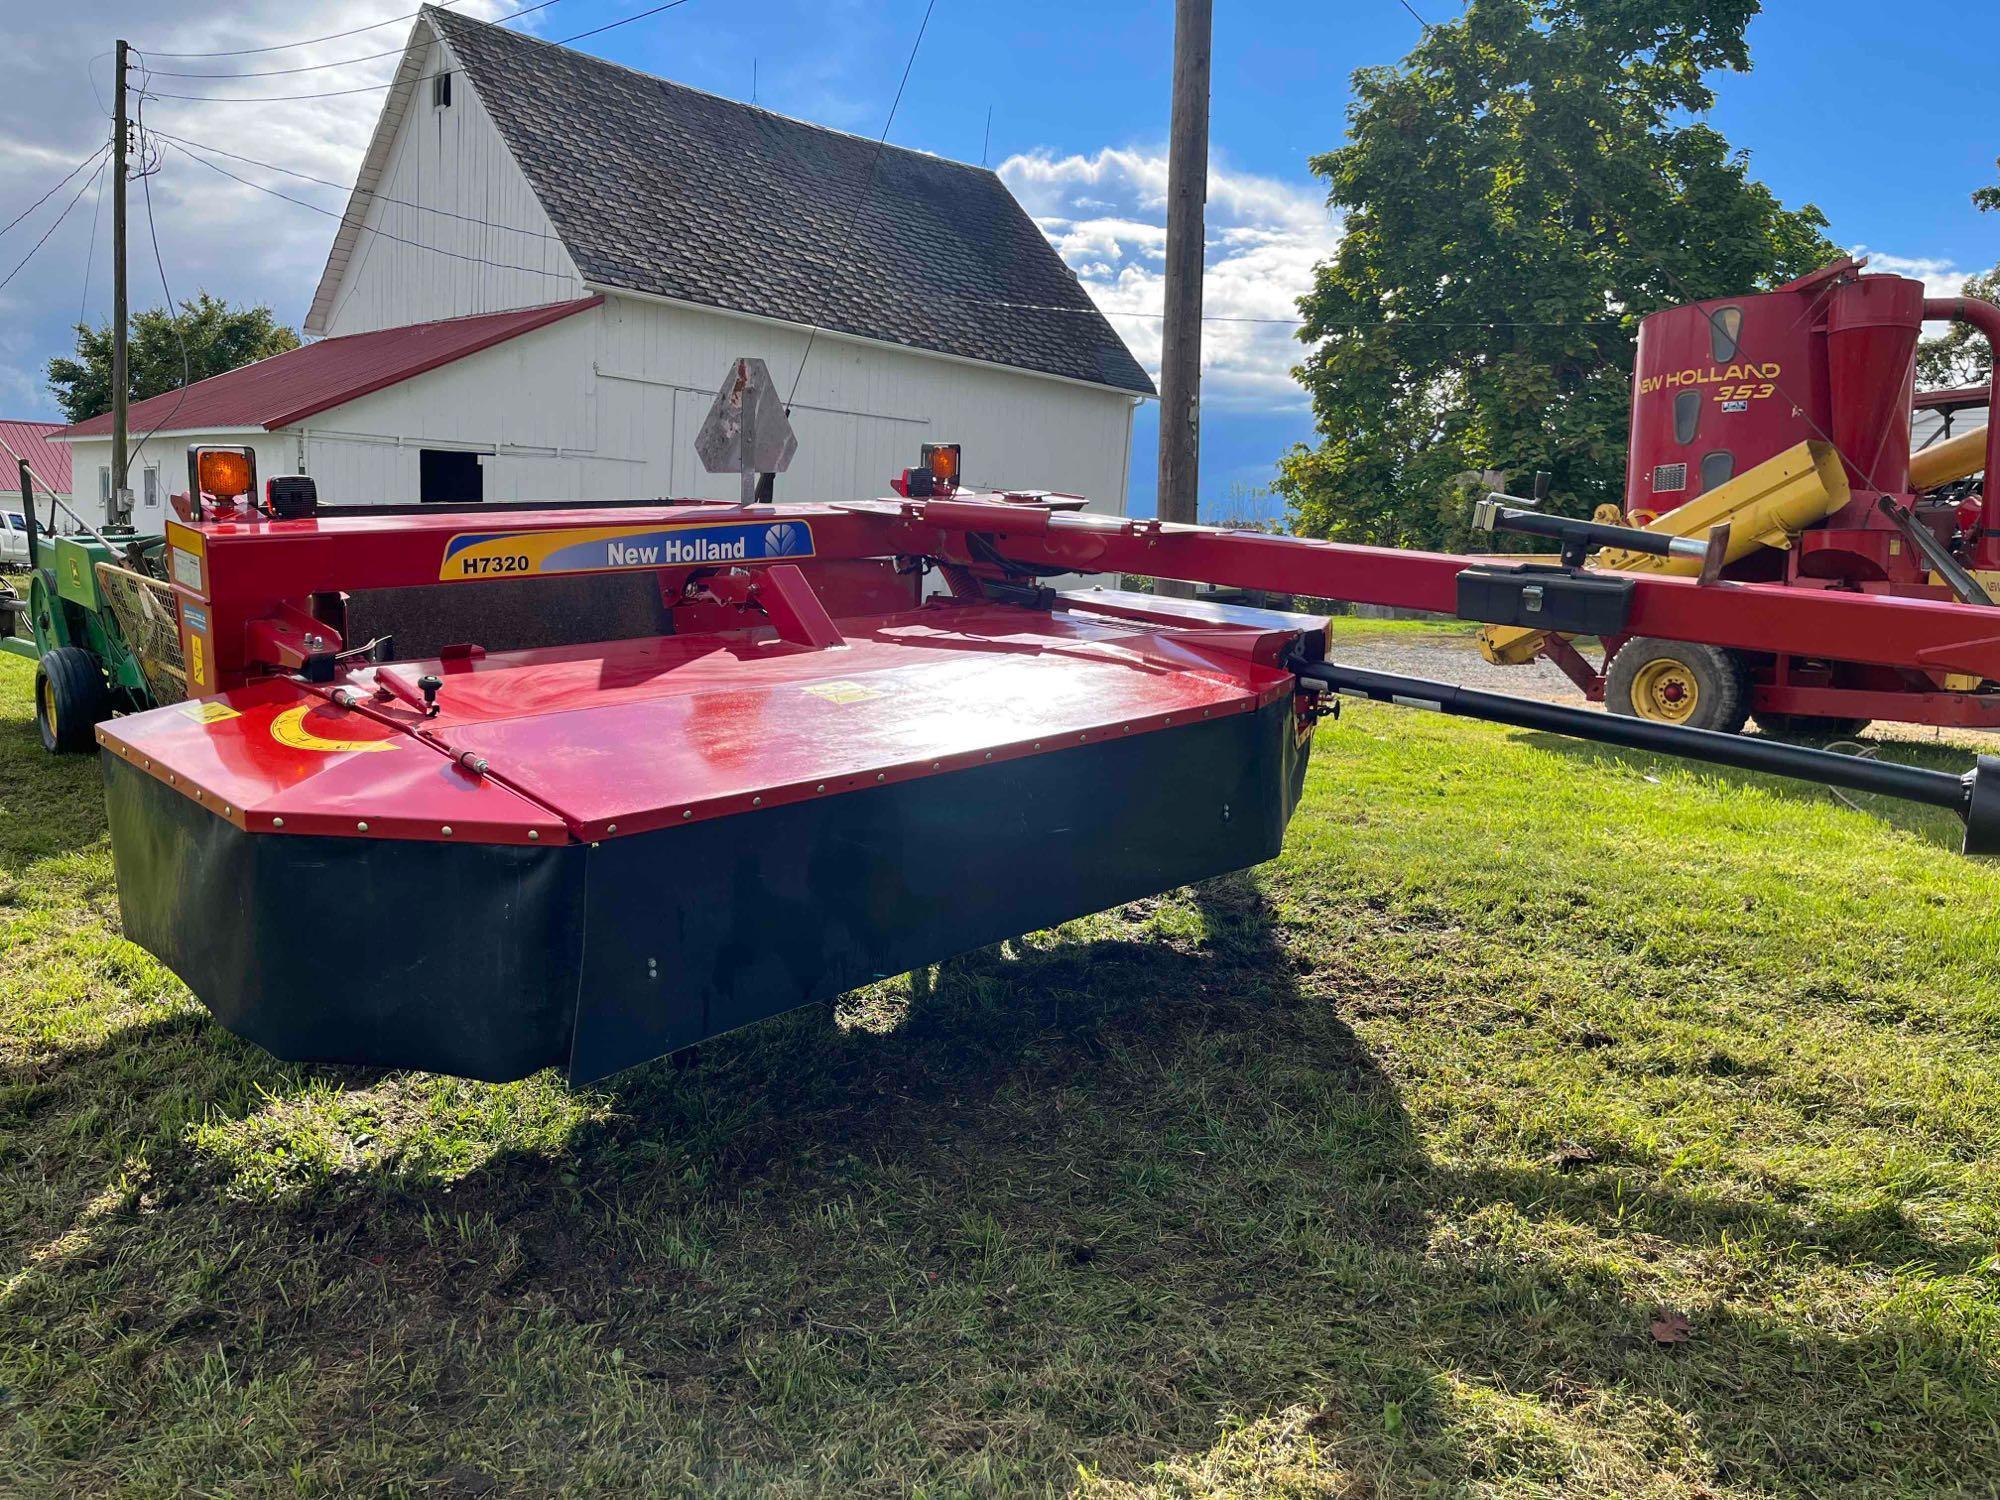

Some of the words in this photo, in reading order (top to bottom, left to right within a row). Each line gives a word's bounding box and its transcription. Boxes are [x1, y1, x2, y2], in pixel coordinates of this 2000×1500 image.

[1666, 363, 1781, 388] HOLLAND
[1713, 383, 1776, 401] 353
[463, 556, 530, 574] H7320
[607, 542, 659, 566] New
[665, 536, 745, 563] Holland
